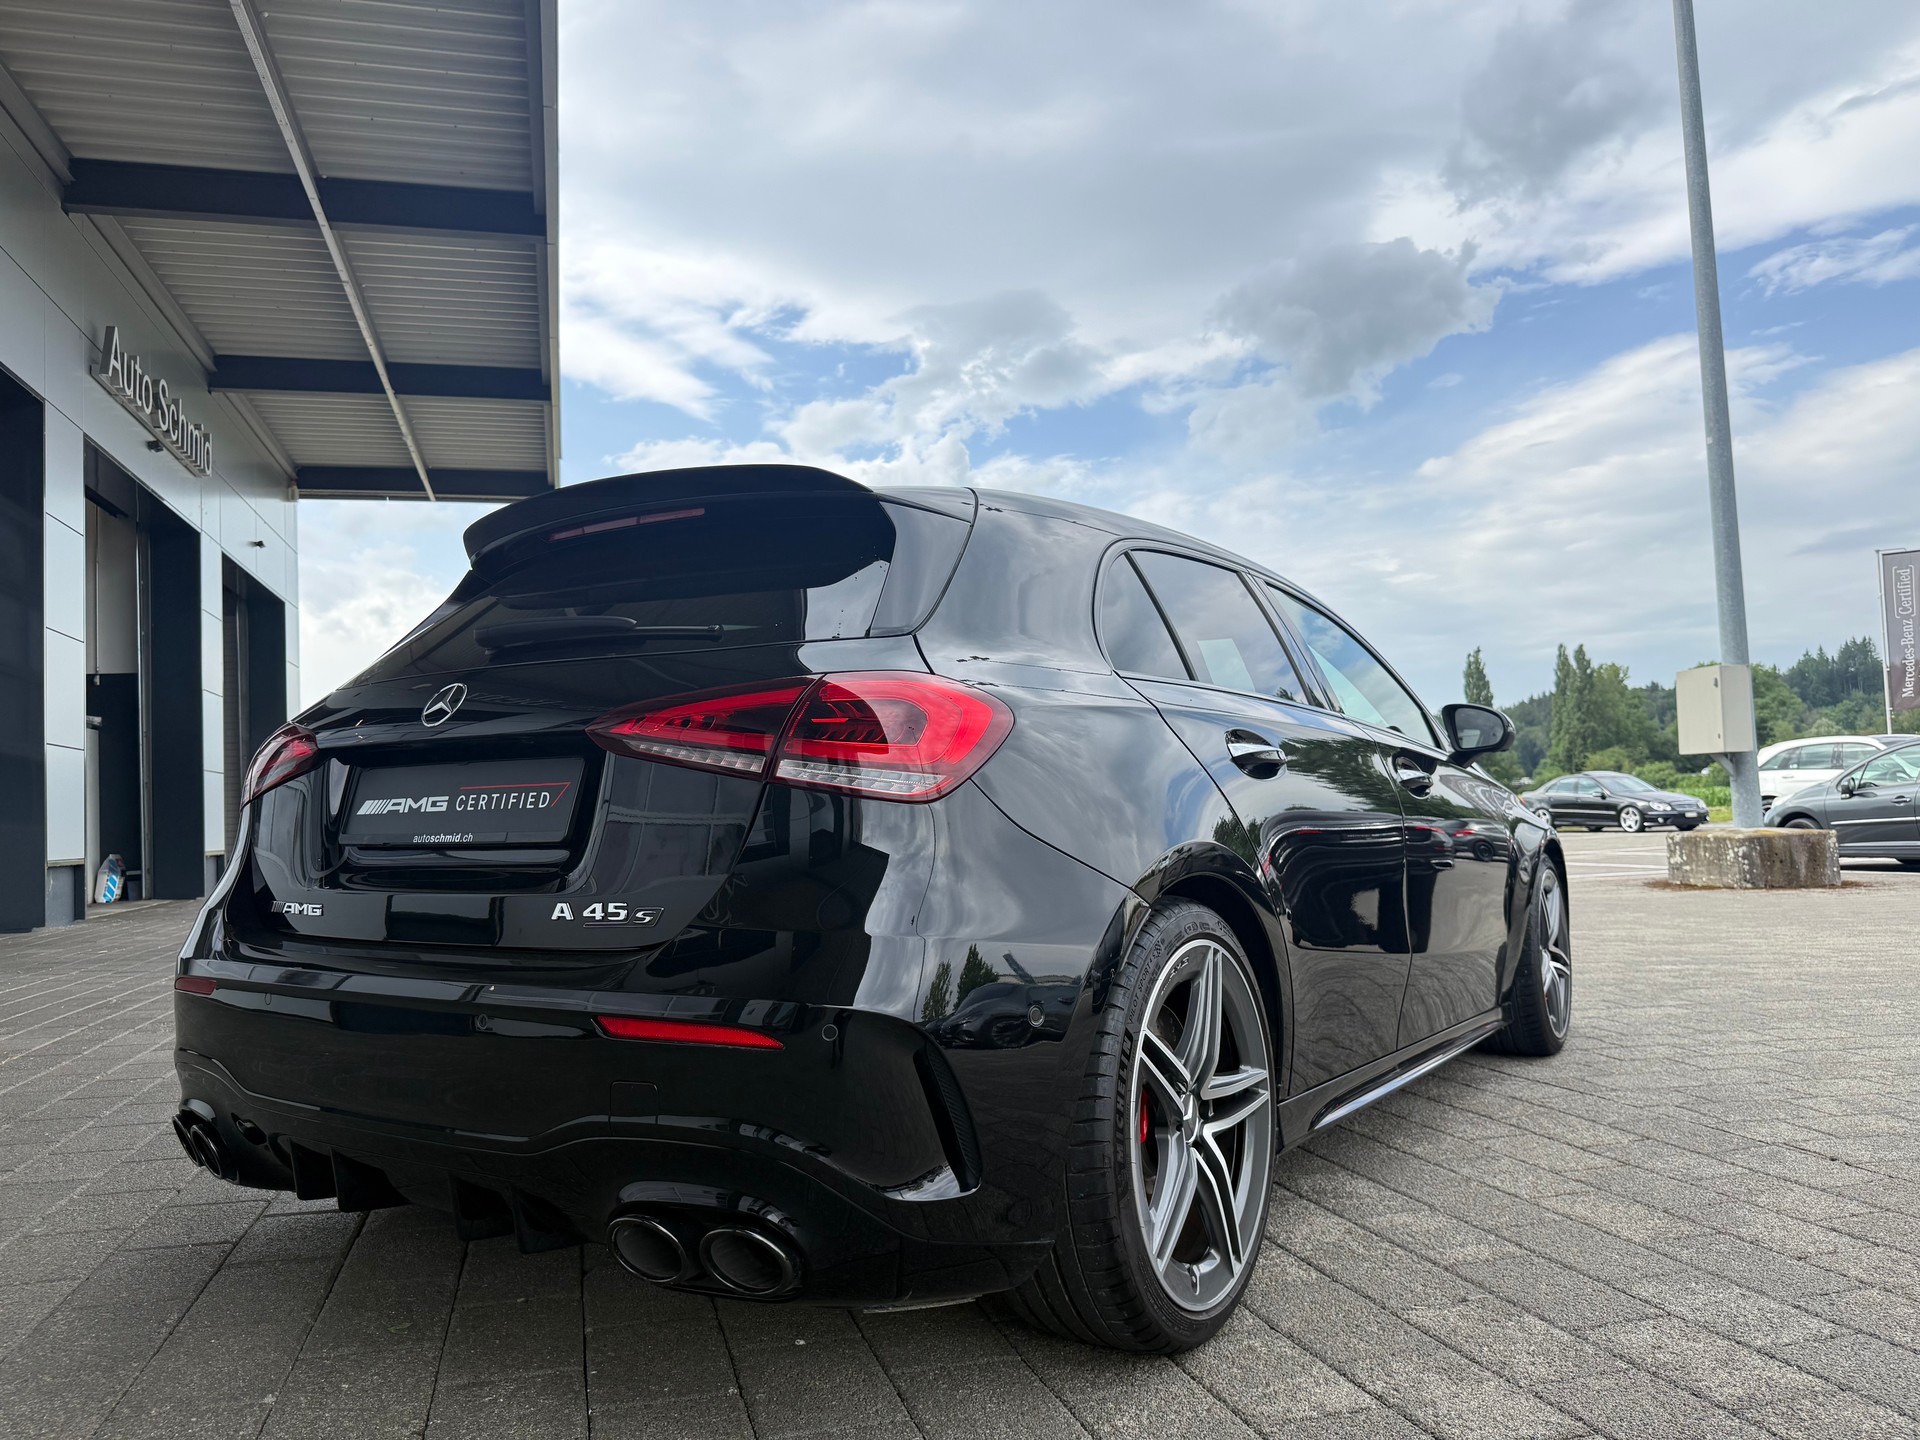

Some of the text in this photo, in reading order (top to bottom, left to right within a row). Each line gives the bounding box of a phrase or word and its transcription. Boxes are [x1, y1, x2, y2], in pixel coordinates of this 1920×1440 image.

[107, 326, 212, 477] Auto Schmid
[1896, 568, 1915, 698] Mercedes-Benz Certified
[384, 791, 550, 814] AMG CERTIFIED
[412, 832, 474, 844] autoschmid.ch
[282, 902, 323, 916] AMG
[551, 902, 574, 920] A
[582, 902, 628, 920] 45
[1128, 995, 1139, 1021] PILOT
[1138, 962, 1151, 990] SPORT
[1115, 1033, 1132, 1163] MICHELIN
